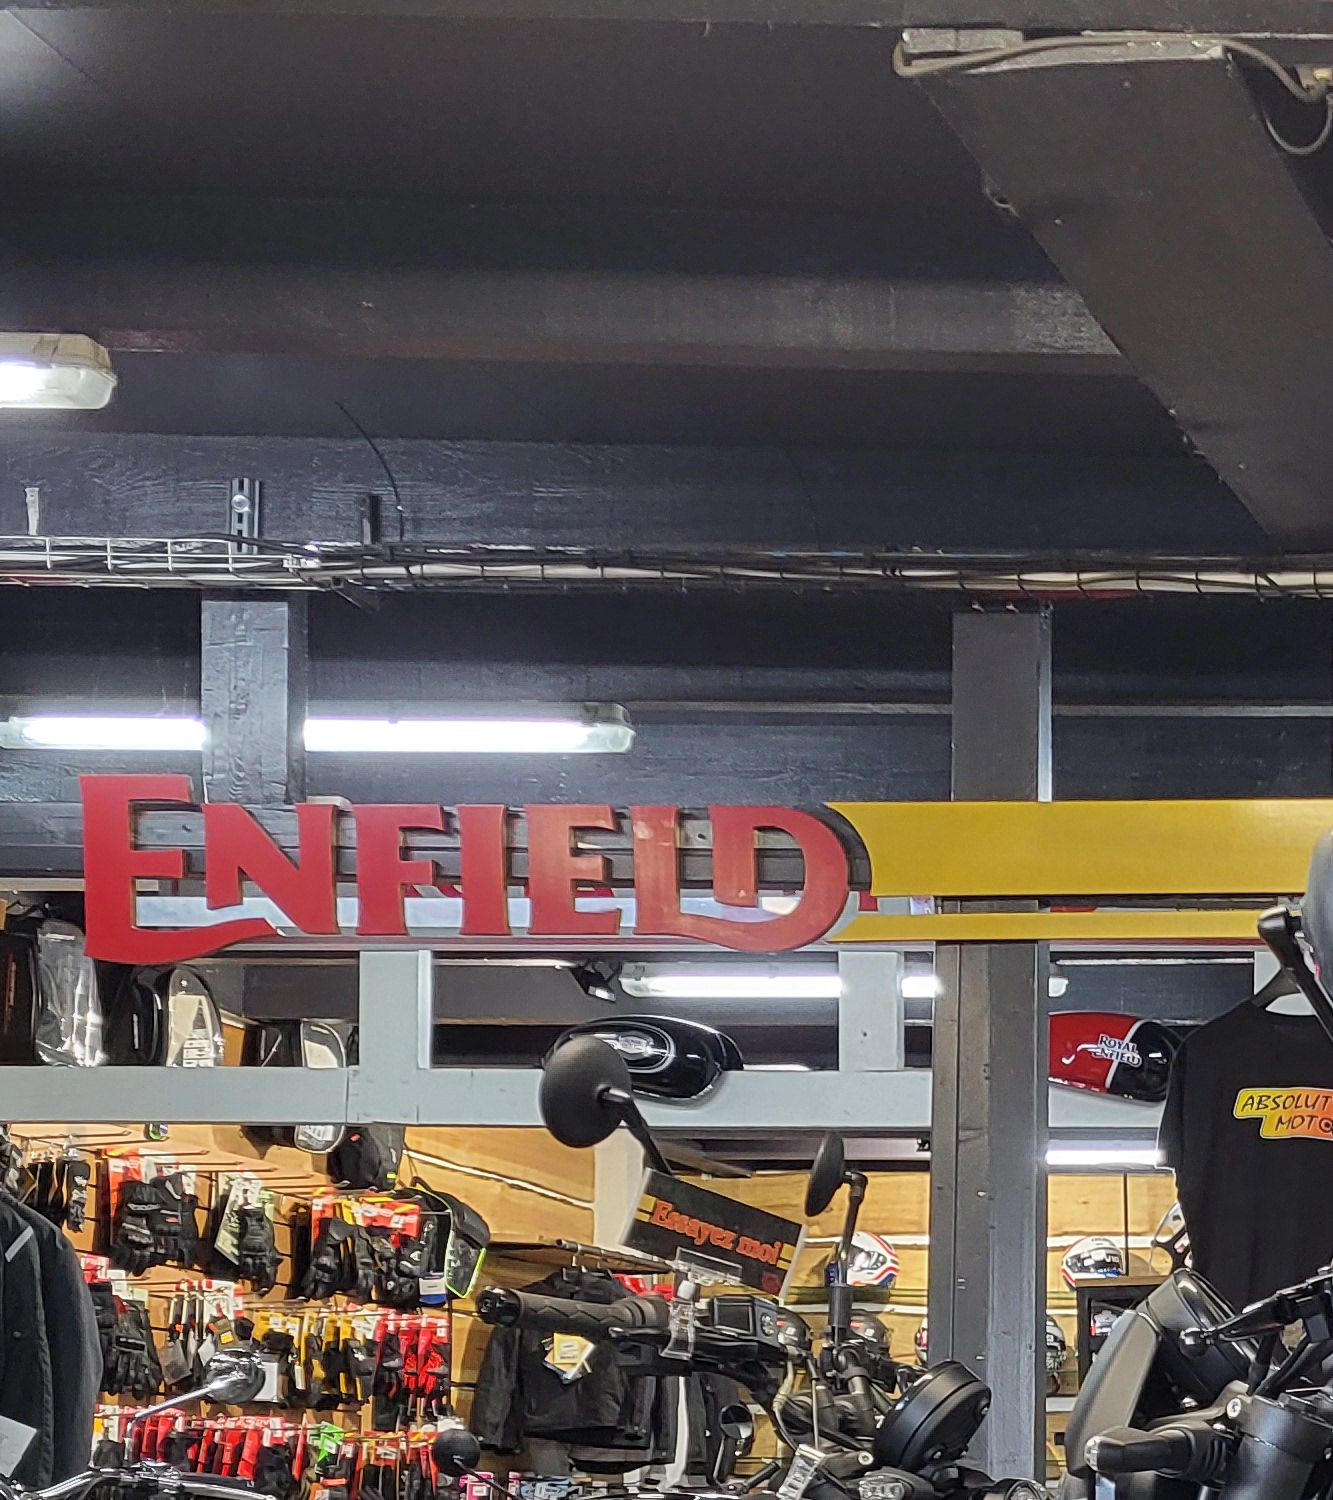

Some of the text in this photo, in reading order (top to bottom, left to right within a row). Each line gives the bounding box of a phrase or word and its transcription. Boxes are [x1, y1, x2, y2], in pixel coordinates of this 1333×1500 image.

[79, 774, 850, 964] ENFIELD
[1100, 1035, 1138, 1053] ROYAL
[650, 1200, 782, 1265] Essayez moi
